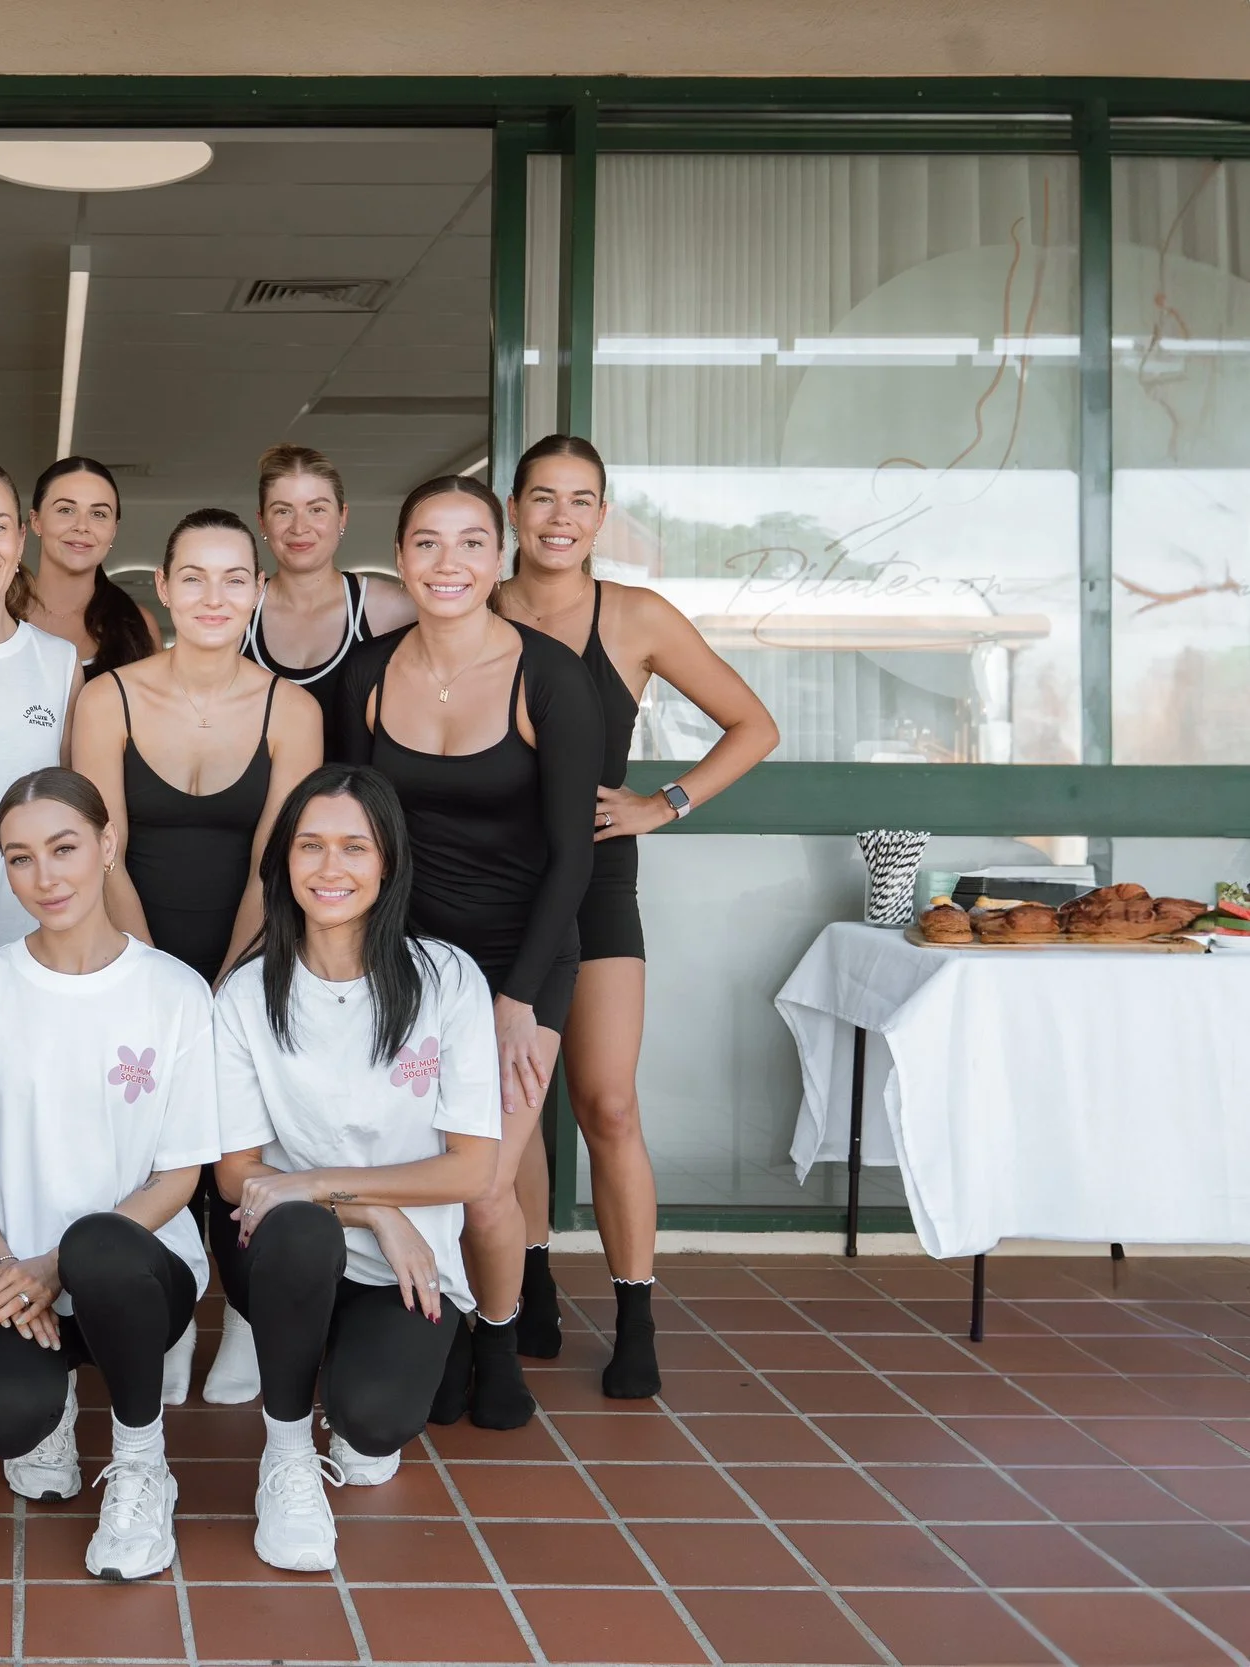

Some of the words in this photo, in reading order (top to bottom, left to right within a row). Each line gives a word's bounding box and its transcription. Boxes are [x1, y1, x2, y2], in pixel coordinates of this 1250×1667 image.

[725, 546, 940, 613] Pilates
[22, 704, 42, 719] LORNA
[43, 707, 57, 724] JANE
[28, 719, 53, 728] ATHLETIC
[119, 1063, 135, 1073] THE
[137, 1067, 151, 1077] MUM
[399, 1061, 416, 1070] THE
[419, 1056, 439, 1068] MUM
[120, 1073, 149, 1085] SOCIETY
[403, 1066, 438, 1079] SOCIETY
